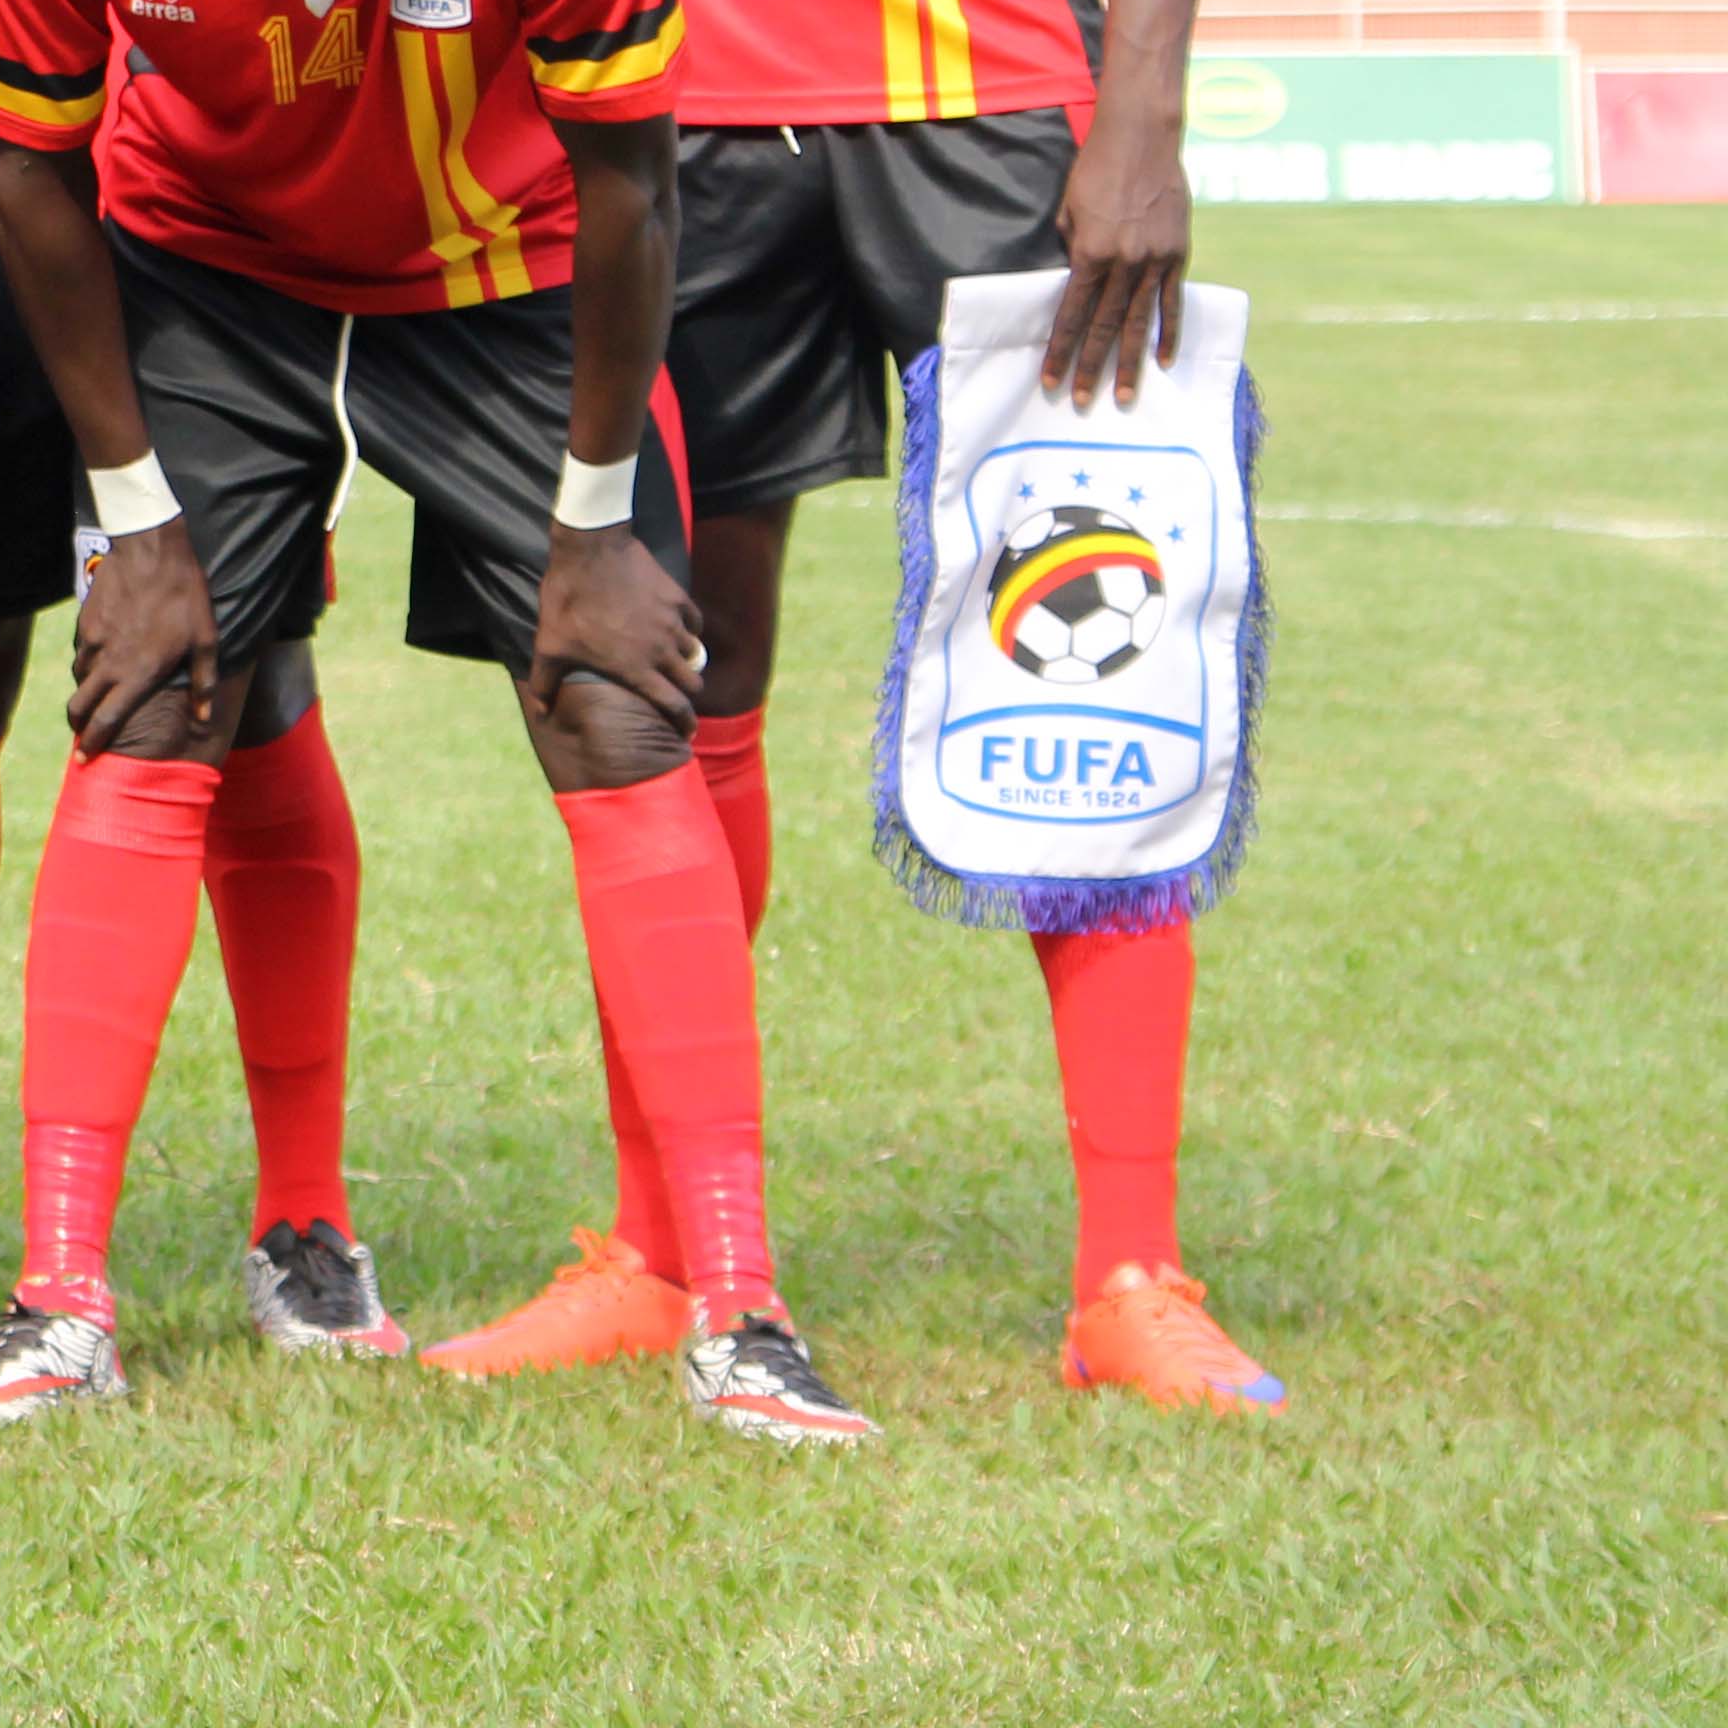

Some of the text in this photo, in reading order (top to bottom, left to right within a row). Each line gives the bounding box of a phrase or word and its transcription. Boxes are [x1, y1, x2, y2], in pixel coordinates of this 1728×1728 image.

[258, 7, 365, 106] 14
[980, 735, 1157, 787] FUFA
[998, 787, 1141, 807] SINCE 1924
